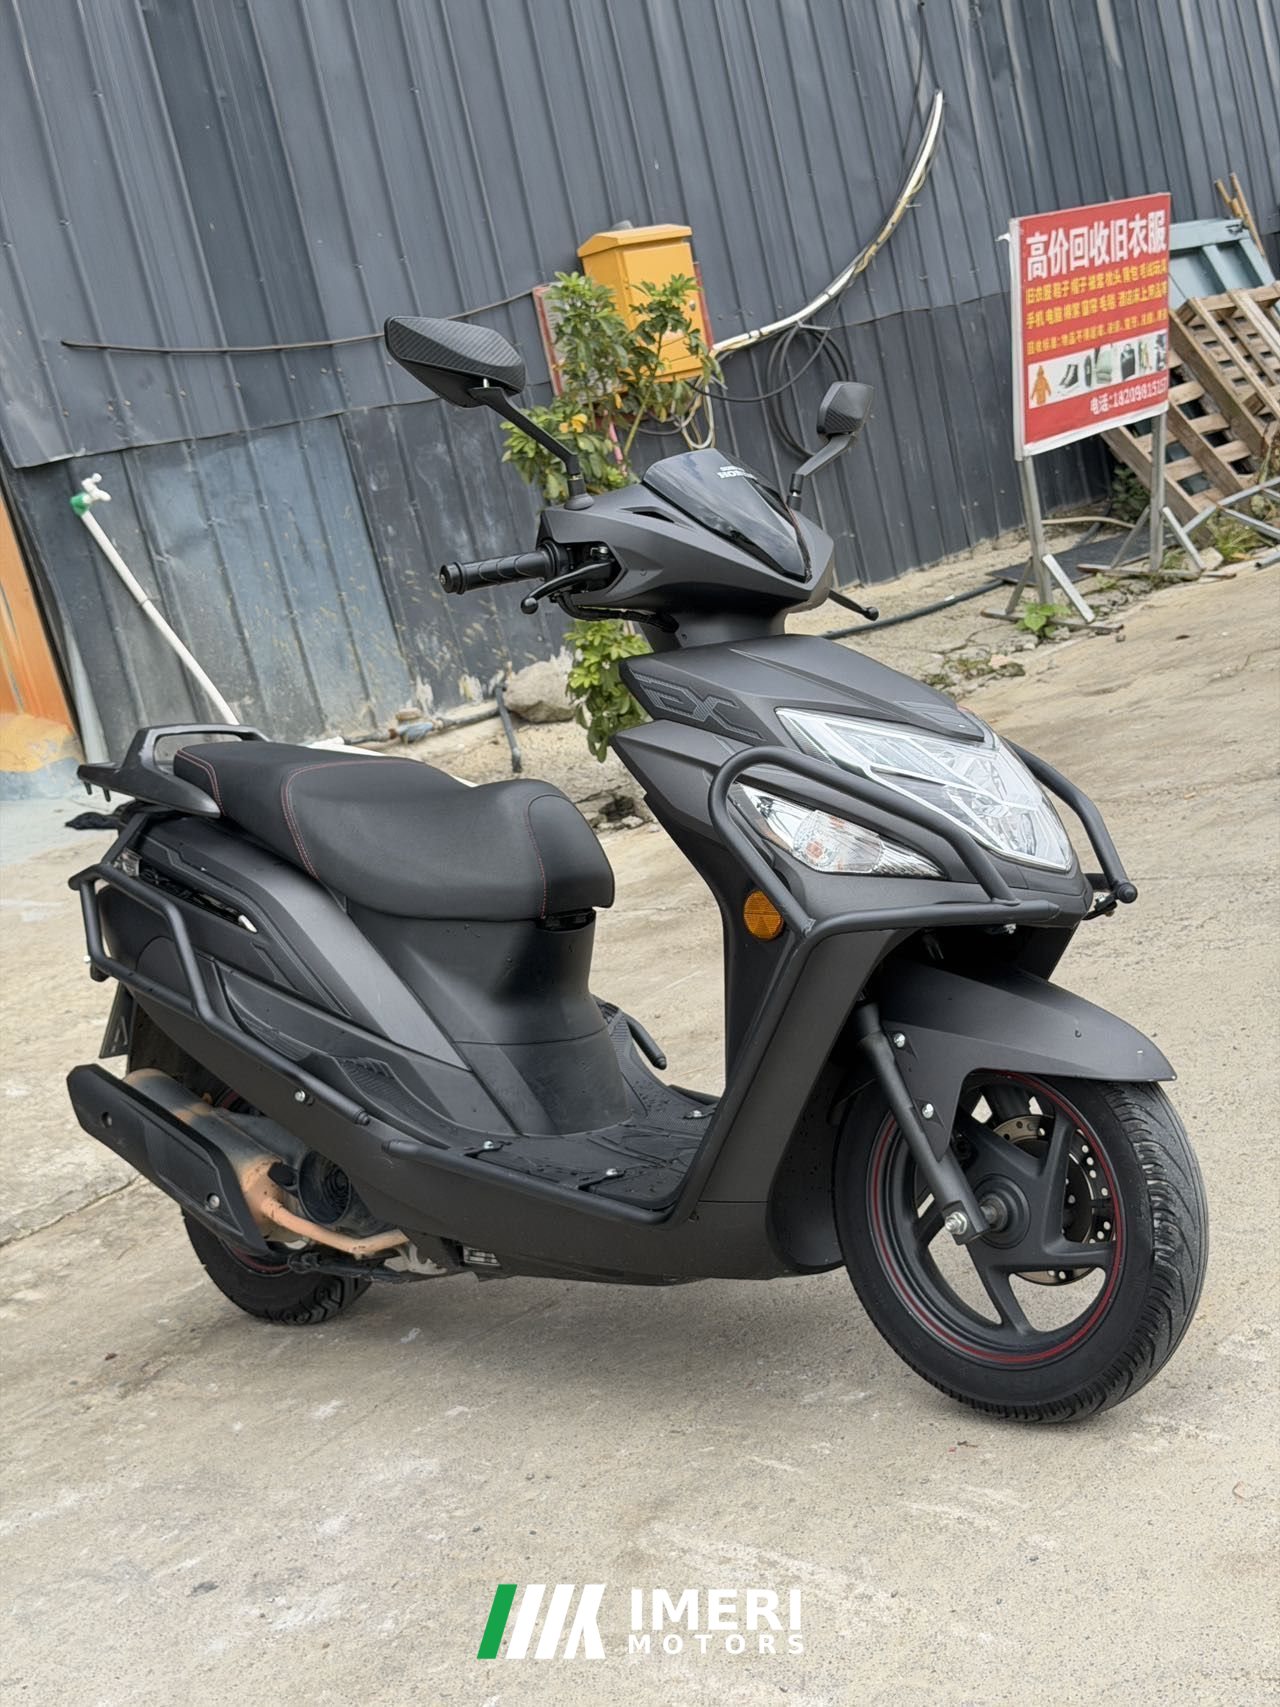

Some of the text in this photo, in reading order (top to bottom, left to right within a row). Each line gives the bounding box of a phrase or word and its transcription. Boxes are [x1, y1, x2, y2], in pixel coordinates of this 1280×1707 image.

[1026, 210, 1167, 281] 高价回收旧衣服
